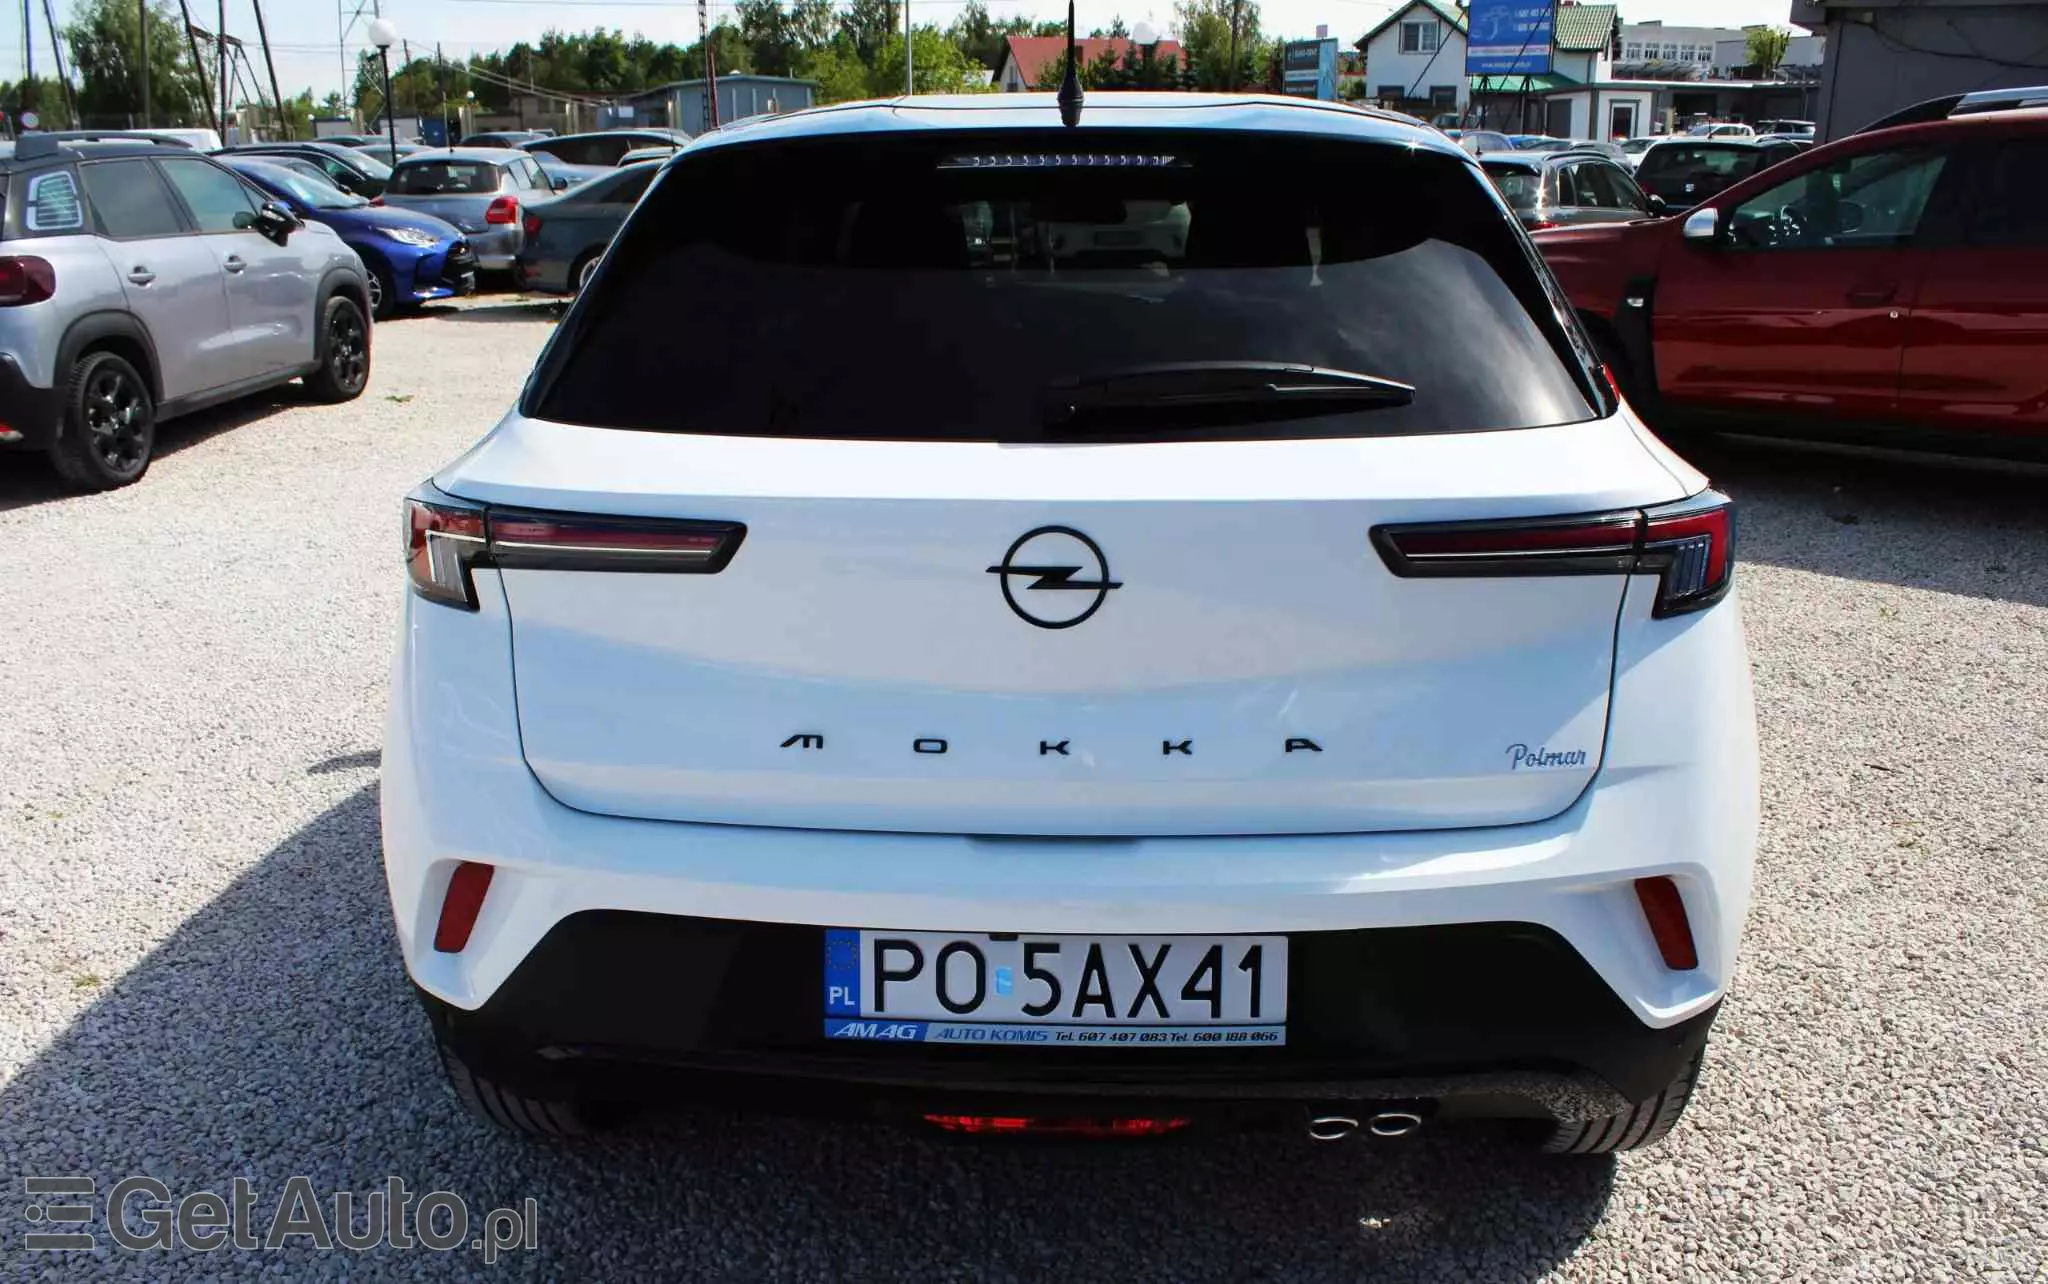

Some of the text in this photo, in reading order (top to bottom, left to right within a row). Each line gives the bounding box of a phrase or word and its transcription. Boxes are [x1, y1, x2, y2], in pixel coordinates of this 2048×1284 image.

[780, 734, 1323, 755] MOKKA
[1505, 743, 1587, 770] Polmar
[873, 938, 1263, 1019] PO 5AX41
[829, 986, 855, 1006] PL
[834, 1023, 918, 1040] AMAG
[936, 1027, 986, 1041] AUTO
[990, 1029, 1048, 1042] KOMIS
[1079, 1032, 1106, 1042] 607
[1109, 1032, 1136, 1042] 407
[1139, 1032, 1168, 1042] 083
[1193, 1032, 1222, 1042] 600
[1250, 1031, 1279, 1042] 066
